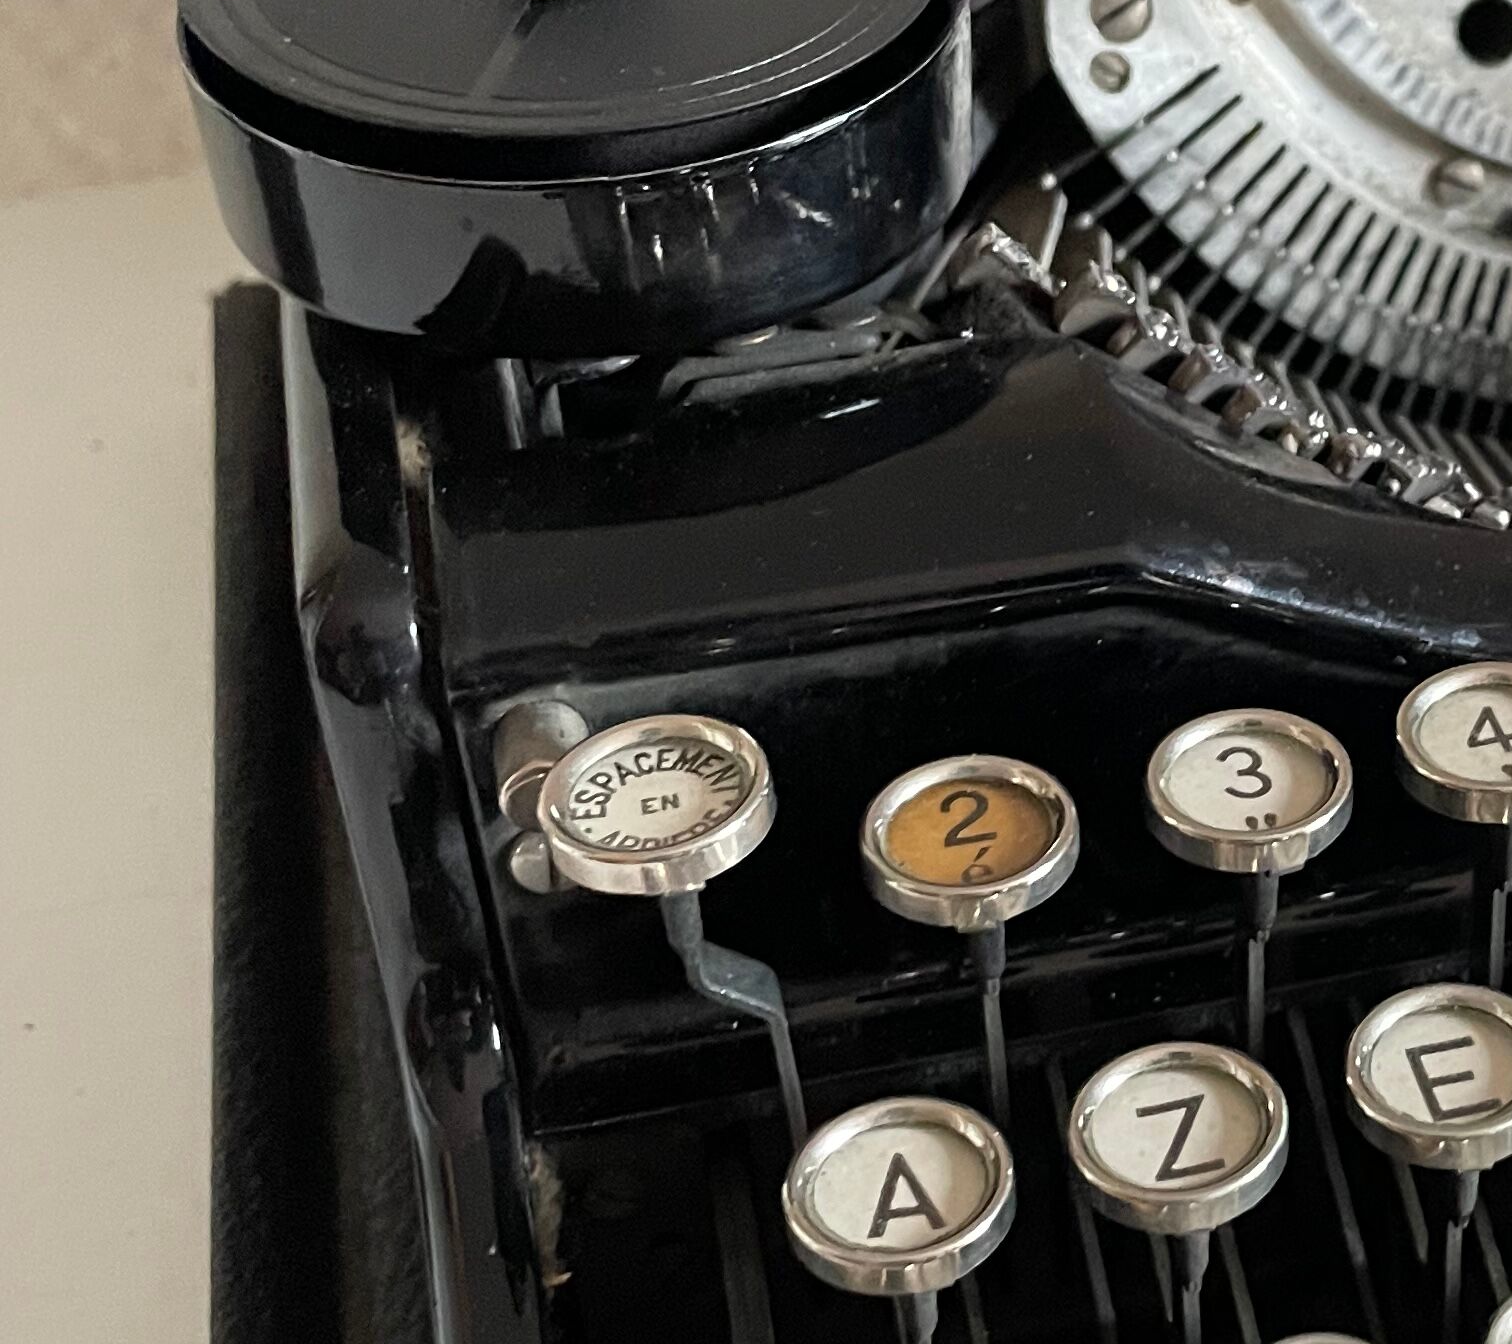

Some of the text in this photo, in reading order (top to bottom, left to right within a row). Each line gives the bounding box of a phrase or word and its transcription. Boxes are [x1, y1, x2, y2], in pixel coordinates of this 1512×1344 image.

[570, 748, 741, 821] ESPACEMENT
[641, 793, 680, 815] EN
[1216, 746, 1272, 799] 3
[940, 790, 998, 848] 2
[1405, 1035, 1502, 1122] E
[1135, 1094, 1226, 1182] Z
[866, 1152, 947, 1239] A
